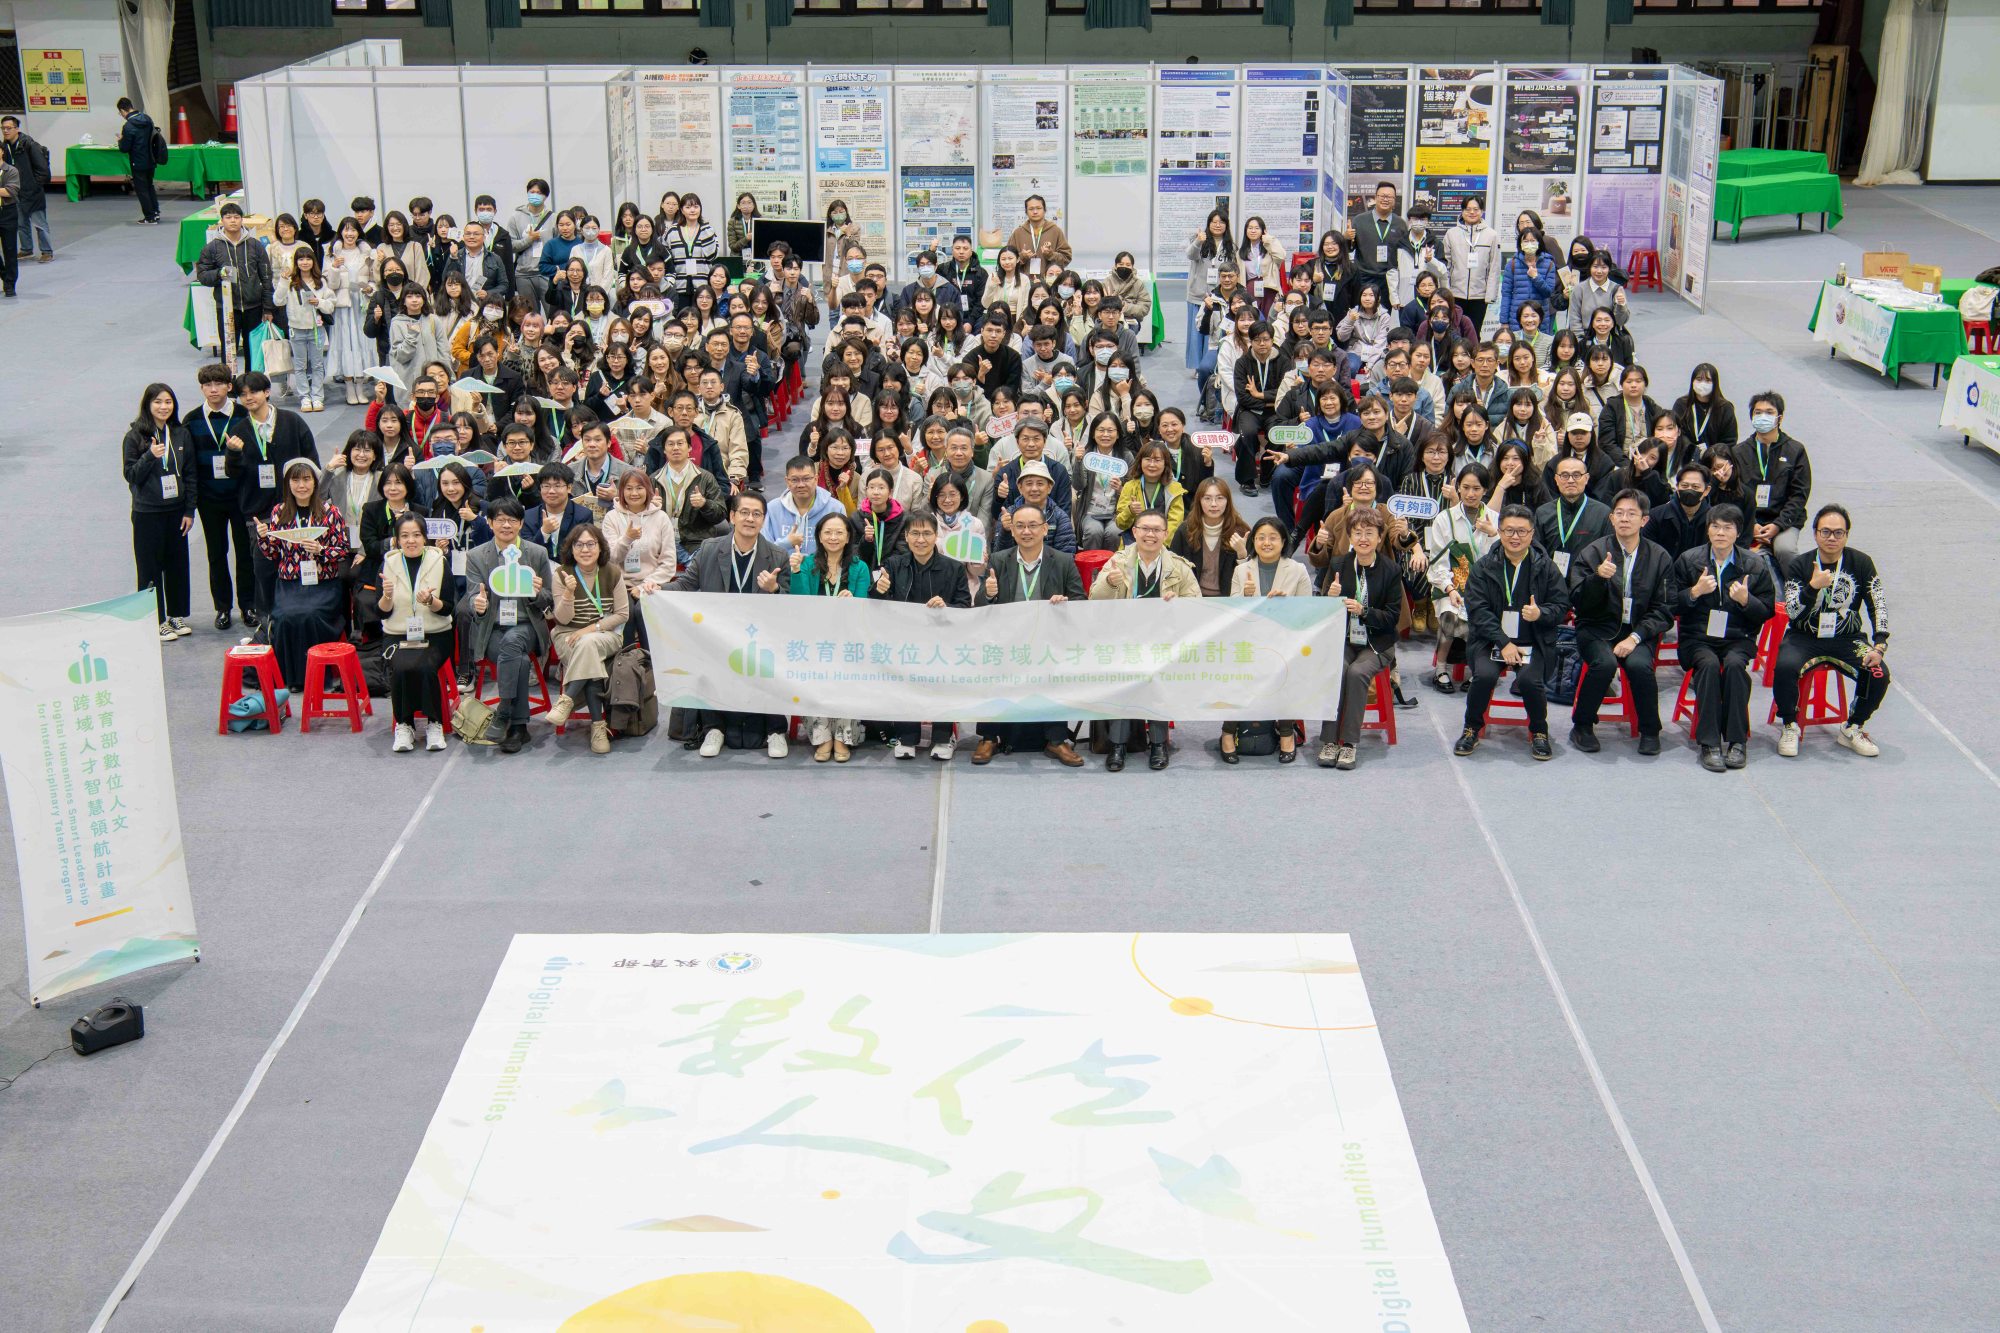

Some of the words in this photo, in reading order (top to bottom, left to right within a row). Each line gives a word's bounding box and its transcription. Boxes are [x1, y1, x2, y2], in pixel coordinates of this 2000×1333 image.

[1879, 265, 1899, 274] VANS
[992, 418, 1013, 435] 太棒
[1274, 429, 1307, 441] 很可以
[1089, 455, 1123, 474] 你最強
[786, 639, 1255, 667] 教育部數位人文跨域人才智慧領航計畫
[786, 670, 828, 681] Digital
[833, 671, 904, 682] Humanities
[909, 673, 946, 684] Smart
[951, 672, 1021, 685] Leadership
[1025, 673, 1042, 683] for
[1048, 671, 1153, 684] Interdisciplinary
[1158, 671, 1196, 682] Talent
[1201, 671, 1255, 683] Program
[36, 703, 47, 719] for
[52, 700, 66, 738] Digital
[40, 723, 60, 816] Interdisciplinary
[58, 742, 74, 805] Humanities
[94, 689, 129, 833] 教育部數位人文
[72, 693, 117, 899] 跨域人才智慧領航計畫
[54, 820, 67, 854] Talent
[68, 808, 81, 841] Smart
[60, 857, 73, 904] Program
[73, 844, 89, 906] Leadership
[523, 976, 562, 1025] Digital
[484, 1031, 541, 1122] Humanities
[1339, 1142, 1388, 1251] Humanities
